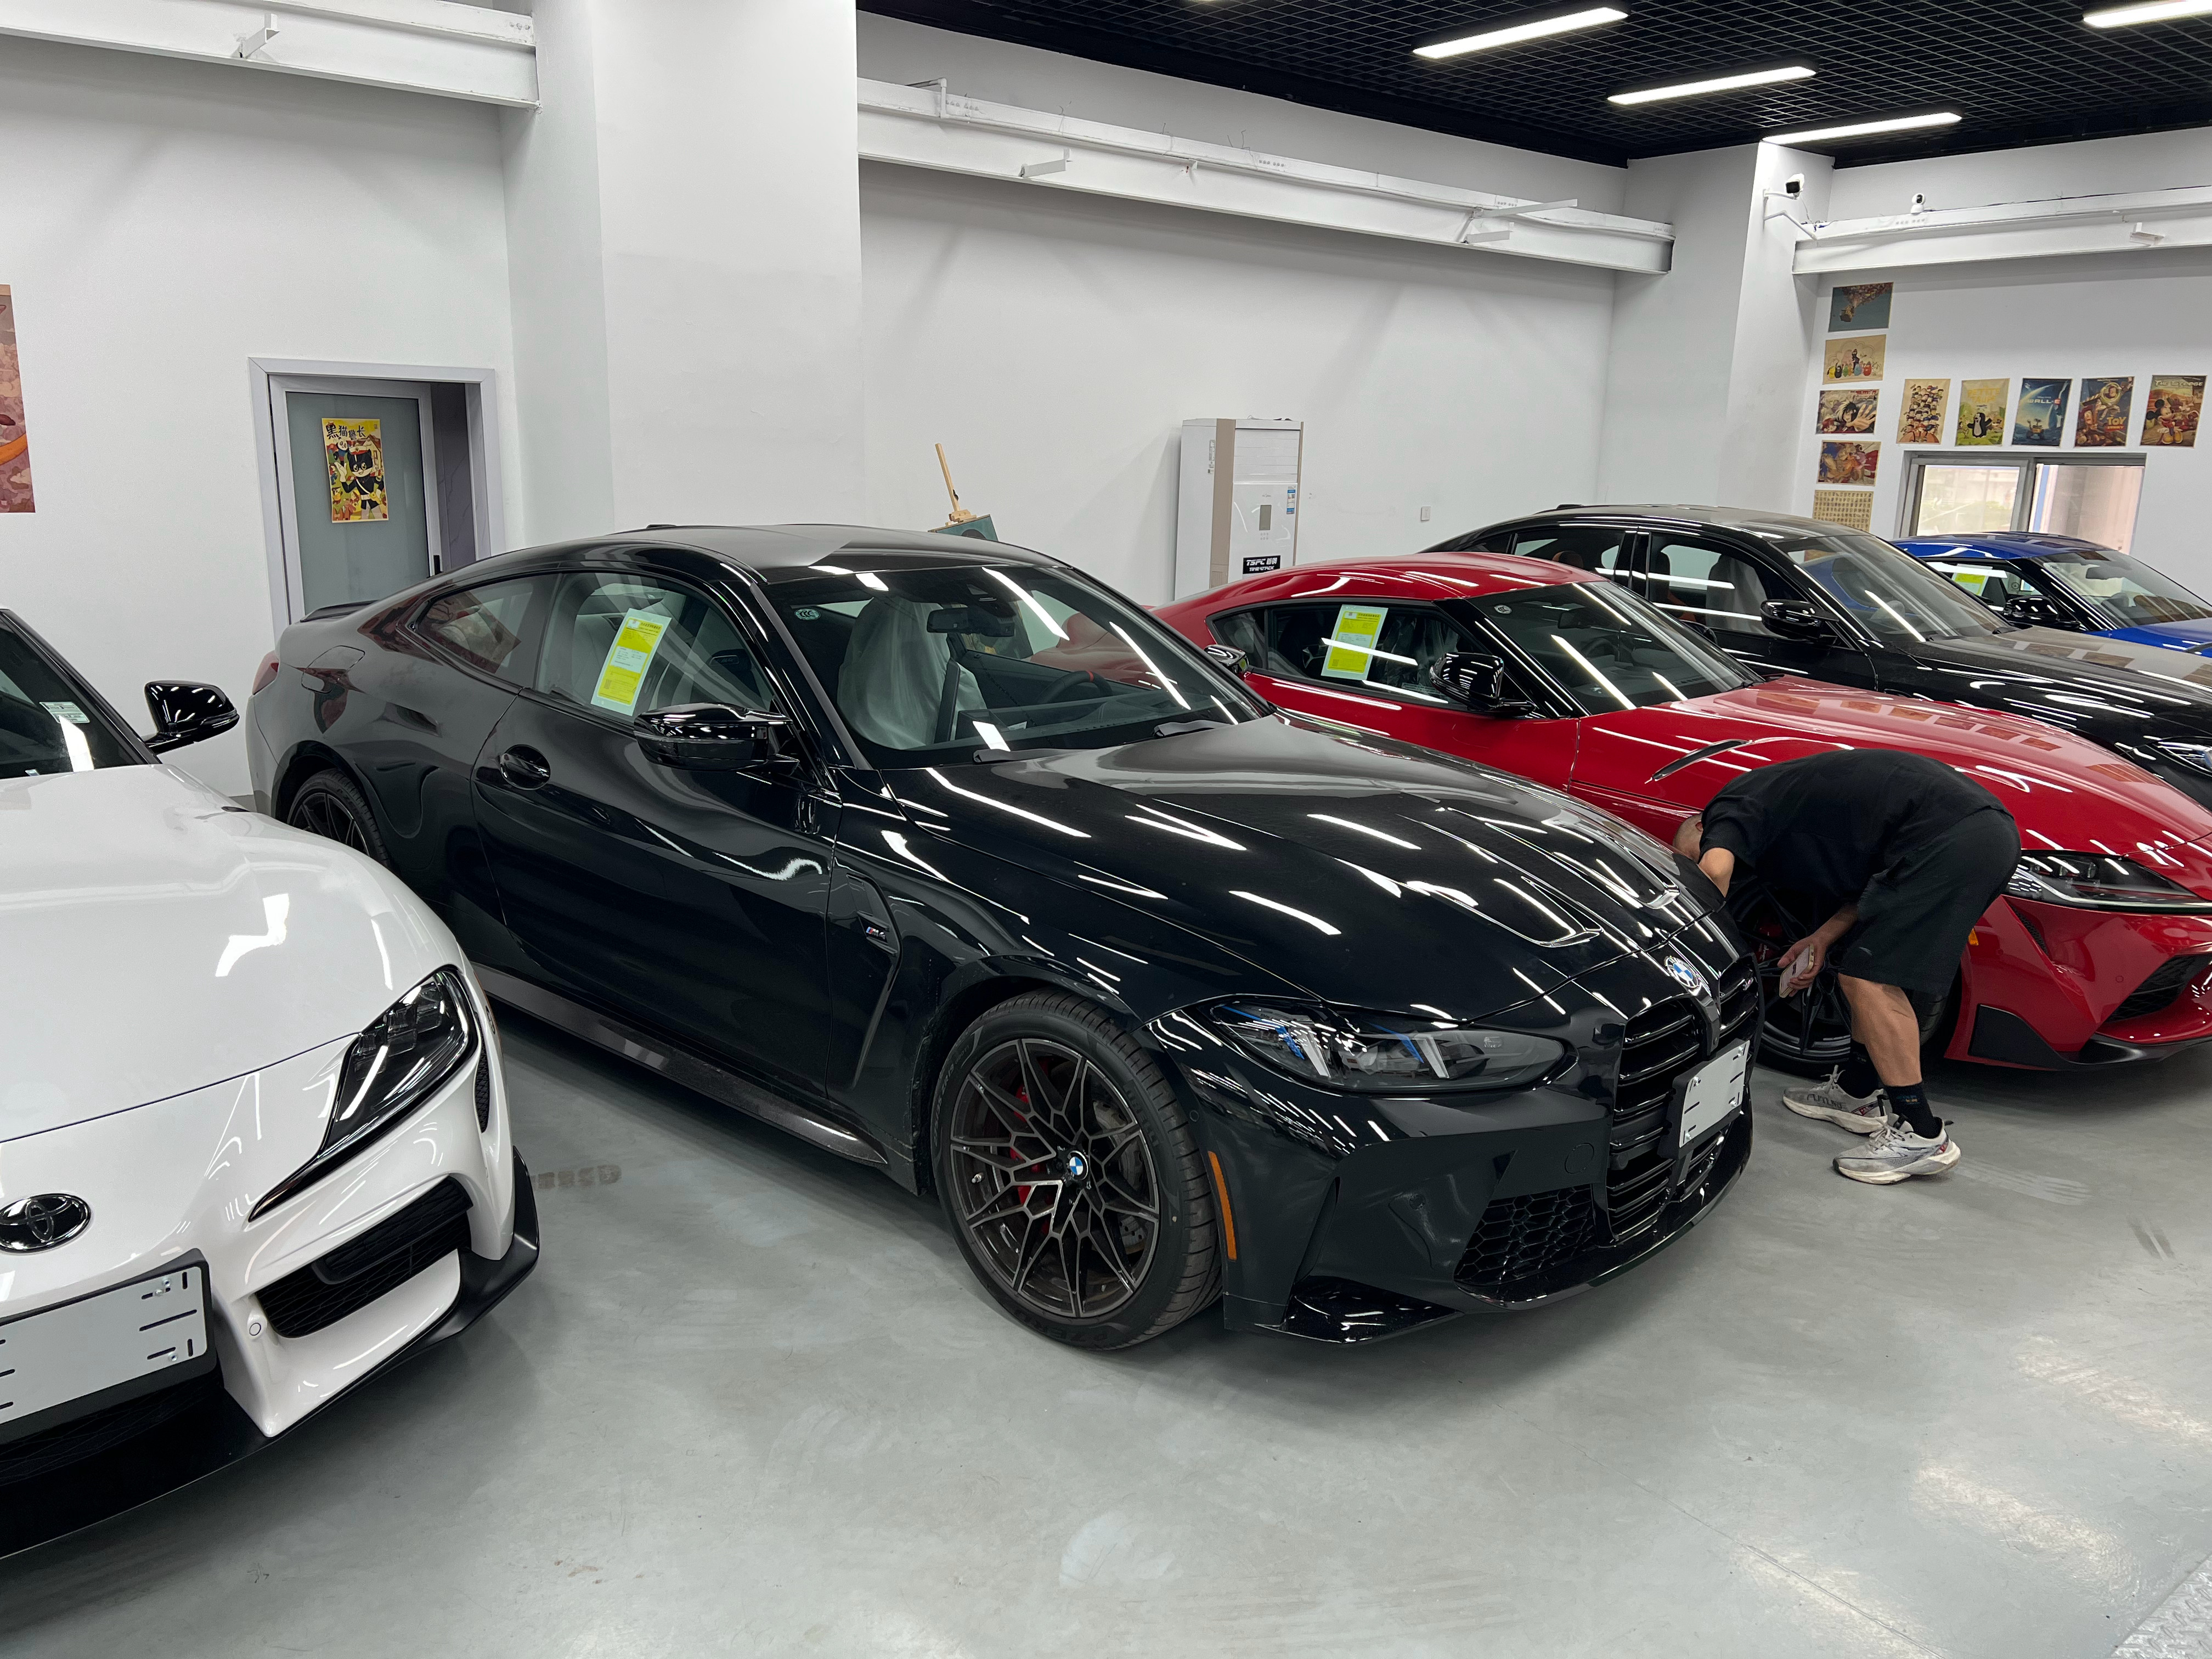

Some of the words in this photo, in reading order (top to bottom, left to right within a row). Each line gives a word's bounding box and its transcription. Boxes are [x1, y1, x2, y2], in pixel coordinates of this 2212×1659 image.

[2106, 416, 2126, 425] TOY
[326, 424, 366, 440] 黑猫警长
